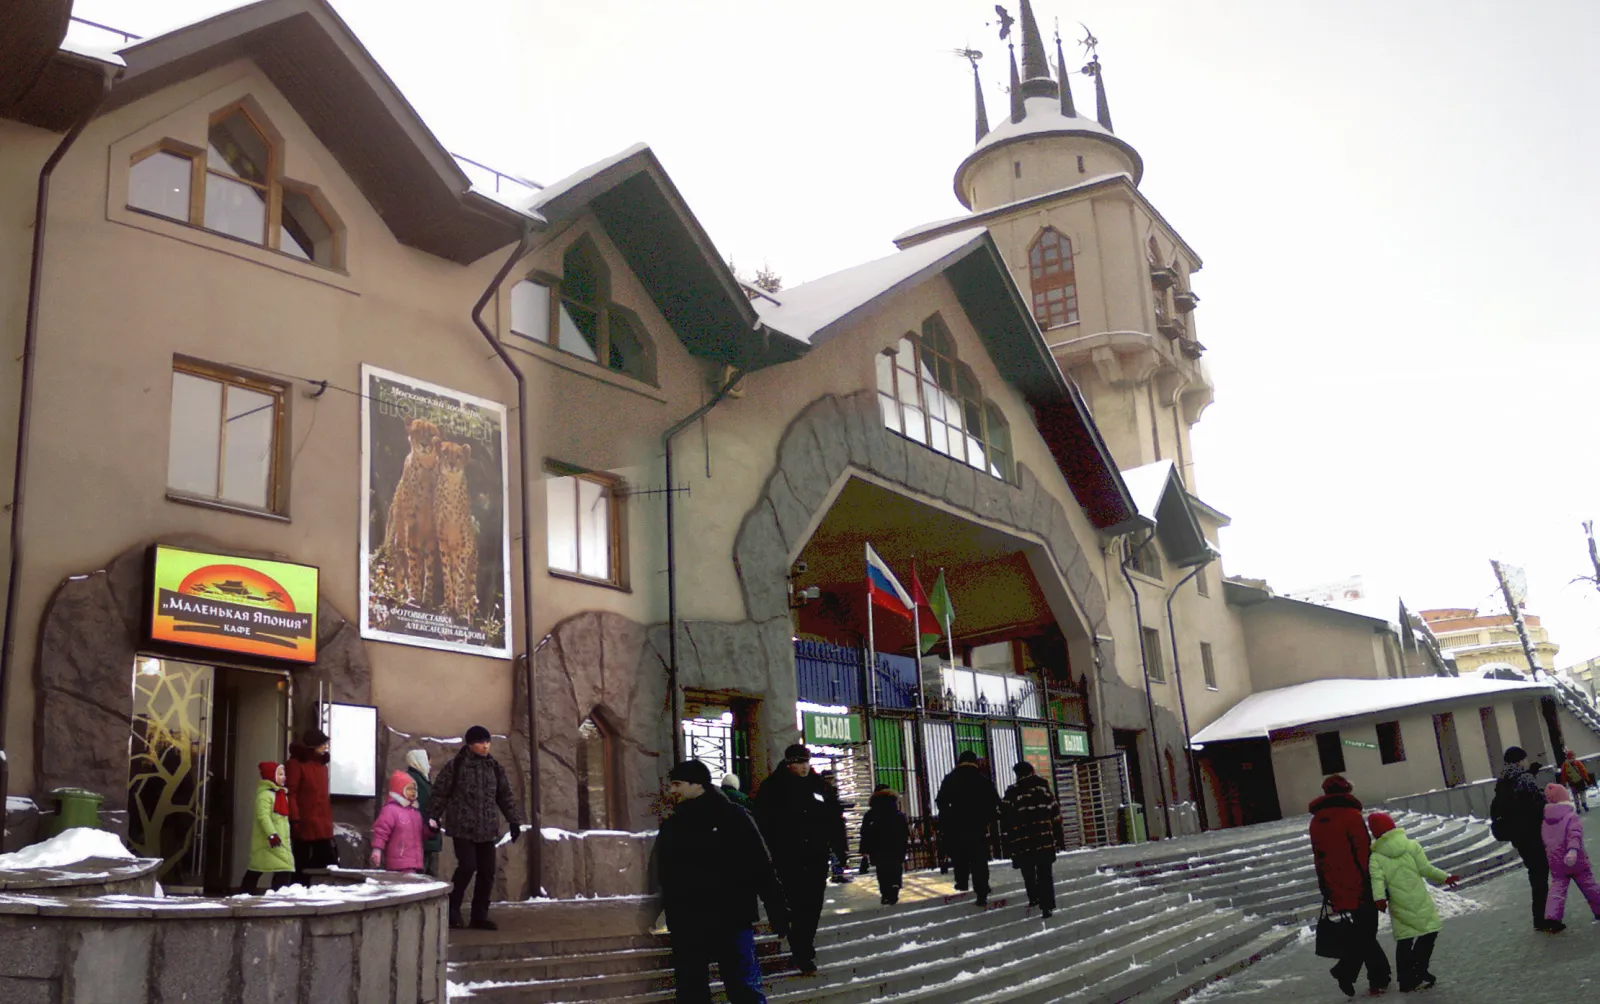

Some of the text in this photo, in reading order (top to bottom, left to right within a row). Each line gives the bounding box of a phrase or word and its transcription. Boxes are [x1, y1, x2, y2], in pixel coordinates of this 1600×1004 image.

[390, 387, 444, 408] Московский
[390, 608, 452, 625] ФОТОВЫСТАВКА
[223, 624, 251, 636] КАФЕ
[405, 622, 453, 636] АЛЕКСАНДРА
[814, 715, 851, 741] ВЫХОД
